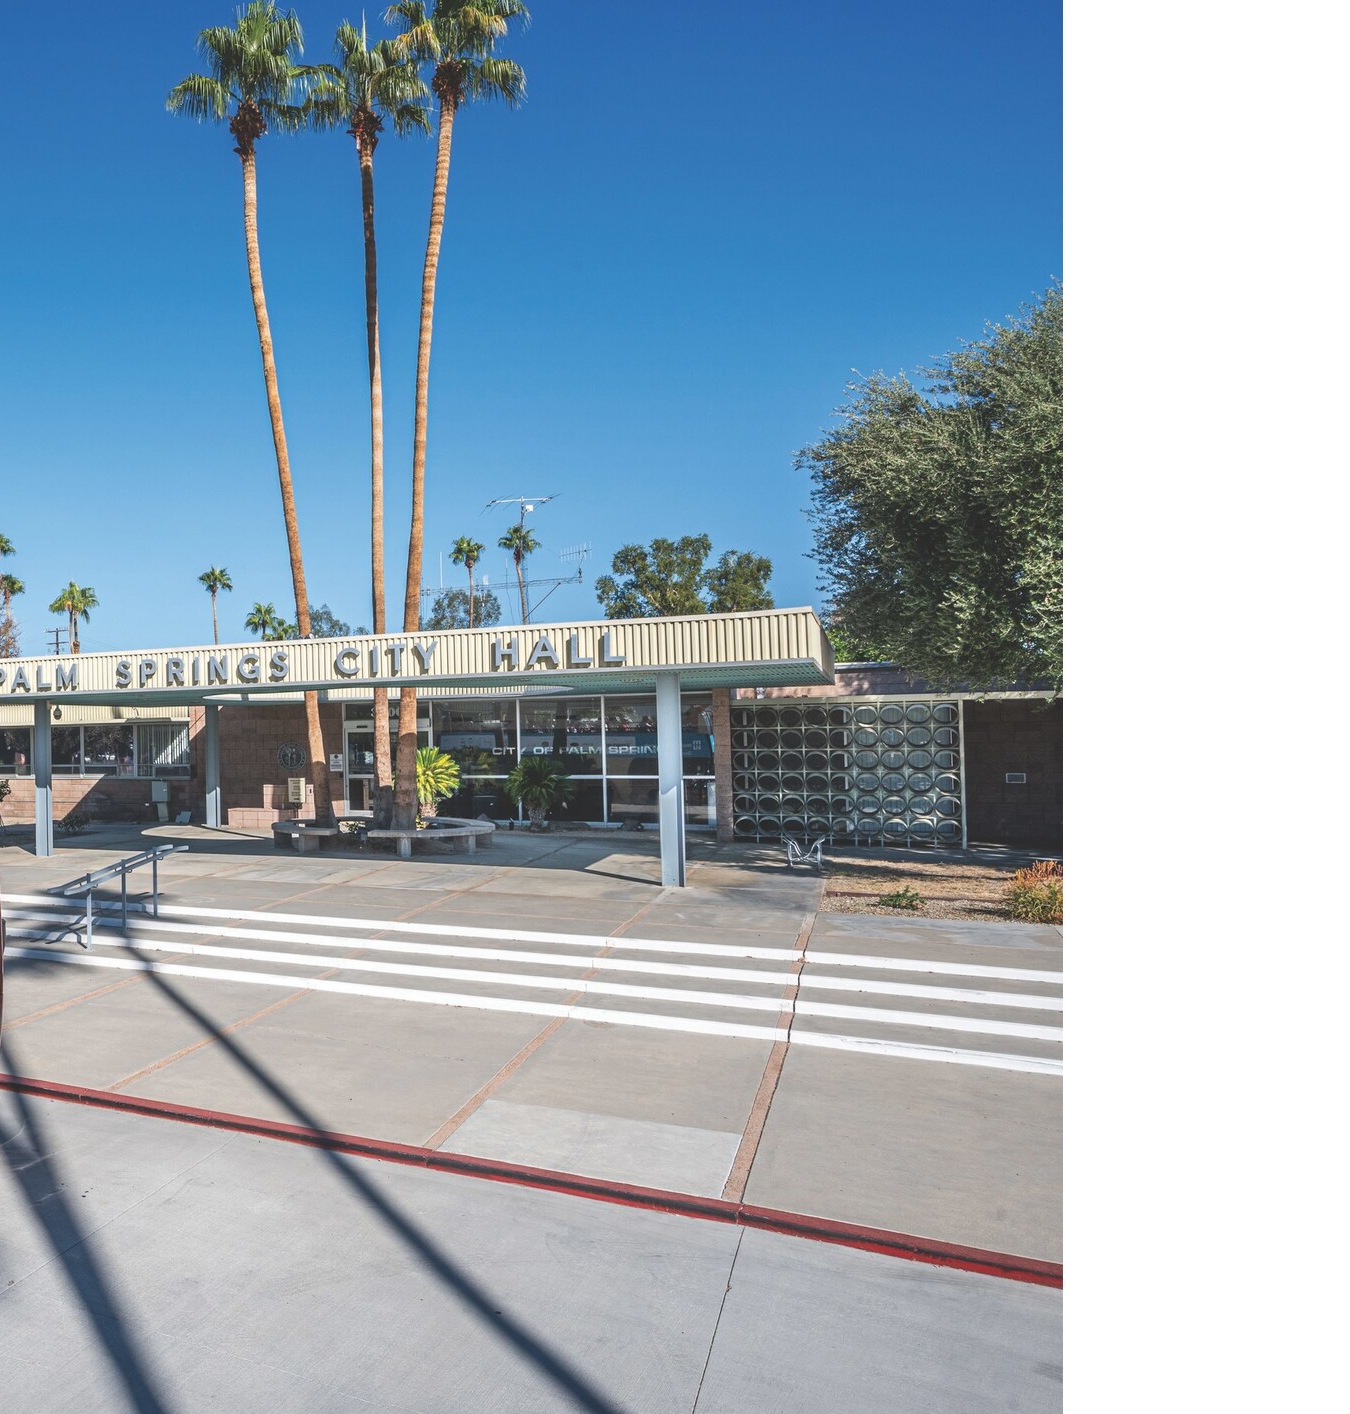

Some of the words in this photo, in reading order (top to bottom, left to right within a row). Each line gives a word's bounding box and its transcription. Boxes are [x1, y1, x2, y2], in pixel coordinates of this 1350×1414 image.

[116, 651, 289, 686] SPRINGS
[335, 640, 438, 675] CITY
[492, 631, 627, 667] HALL
[492, 746, 527, 755] CITY
[534, 746, 554, 755] OF
[559, 746, 602, 754] PALM
[608, 745, 658, 754] SPRIN
